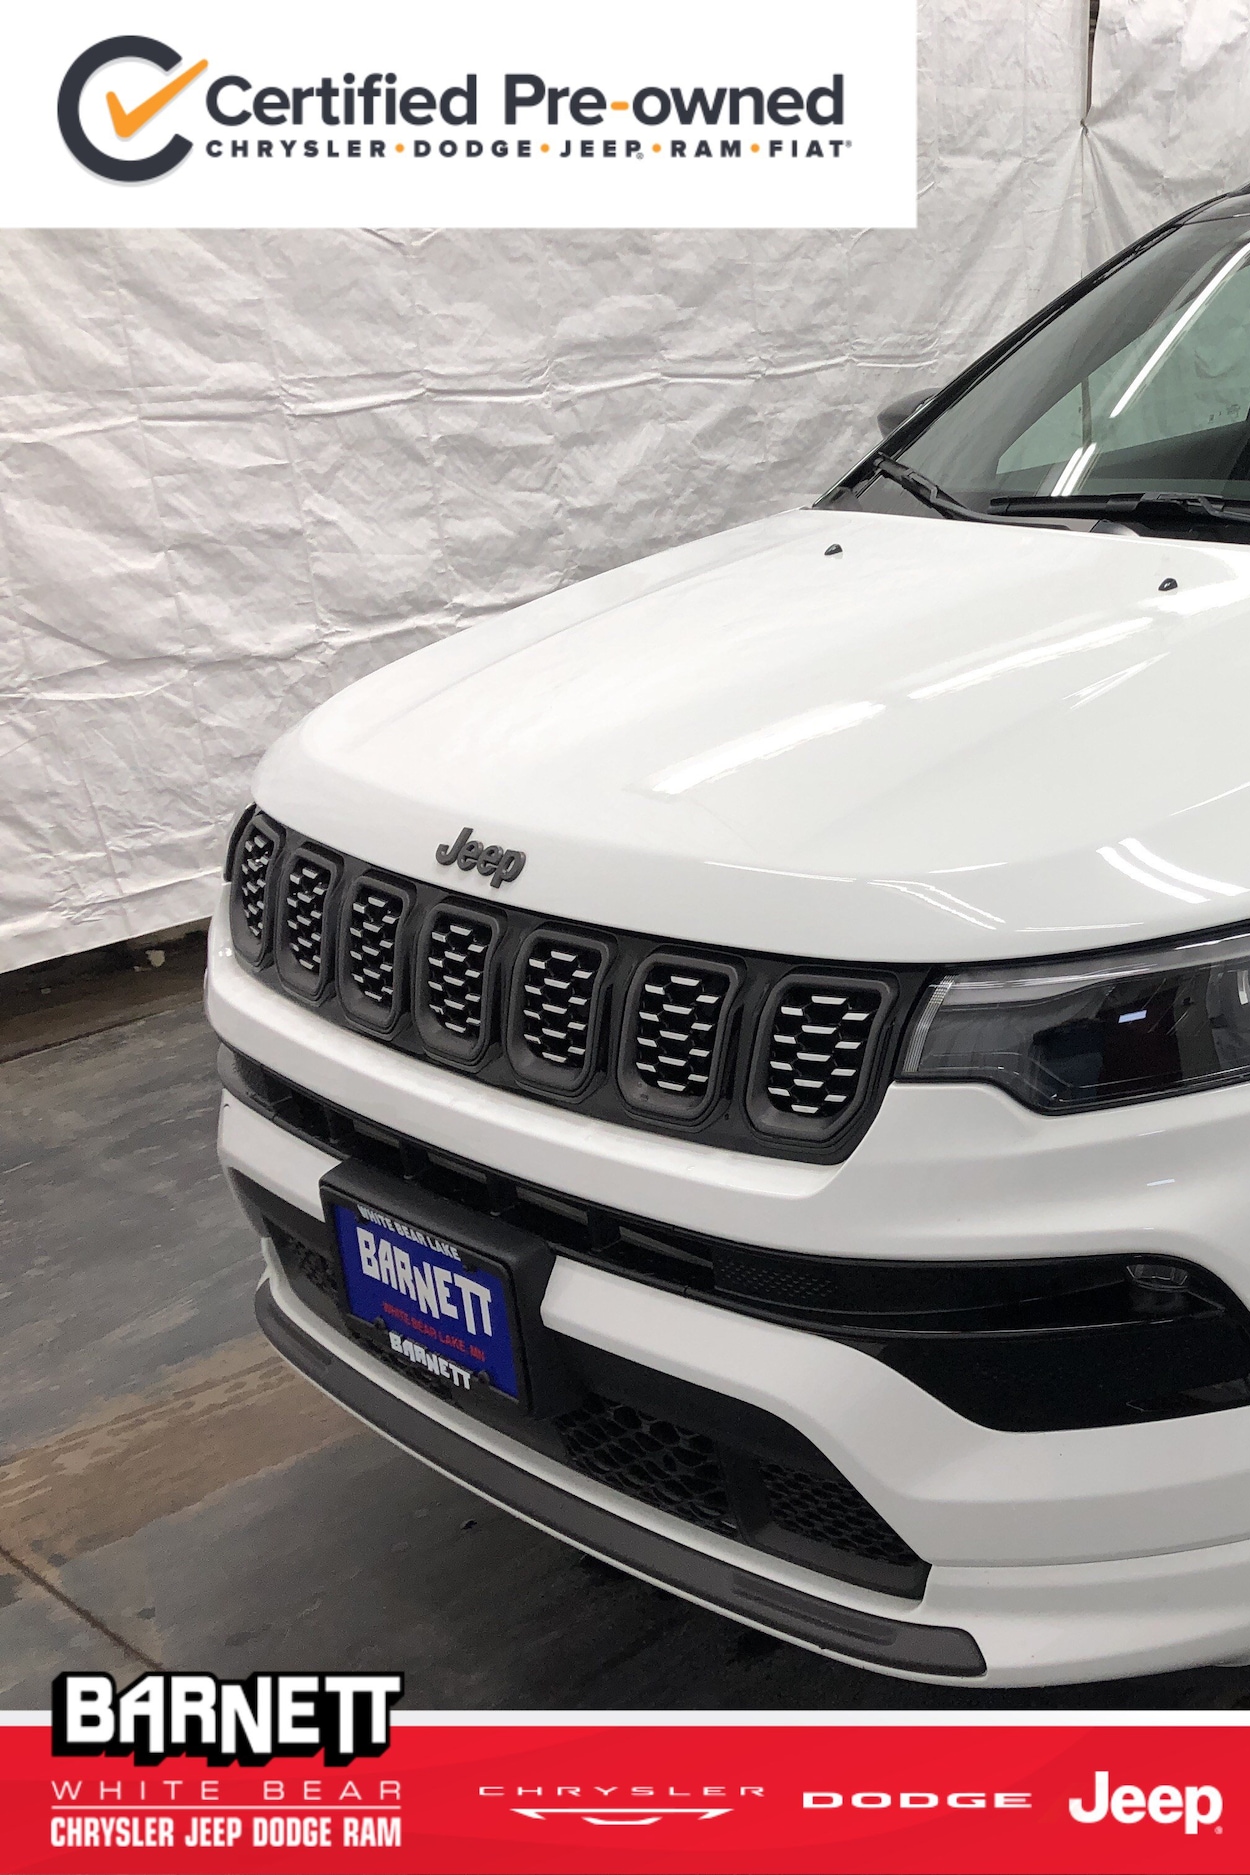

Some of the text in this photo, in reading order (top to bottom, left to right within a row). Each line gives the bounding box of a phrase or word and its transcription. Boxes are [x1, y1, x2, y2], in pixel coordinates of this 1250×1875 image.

[436, 827, 526, 888] Jeep
[357, 1204, 462, 1262] WHITE BEAR LAKE
[356, 1226, 493, 1337] BARNETT
[383, 1302, 411, 1326] WHITE
[411, 1317, 437, 1339] BEAR
[388, 1331, 471, 1390] BARNETT
